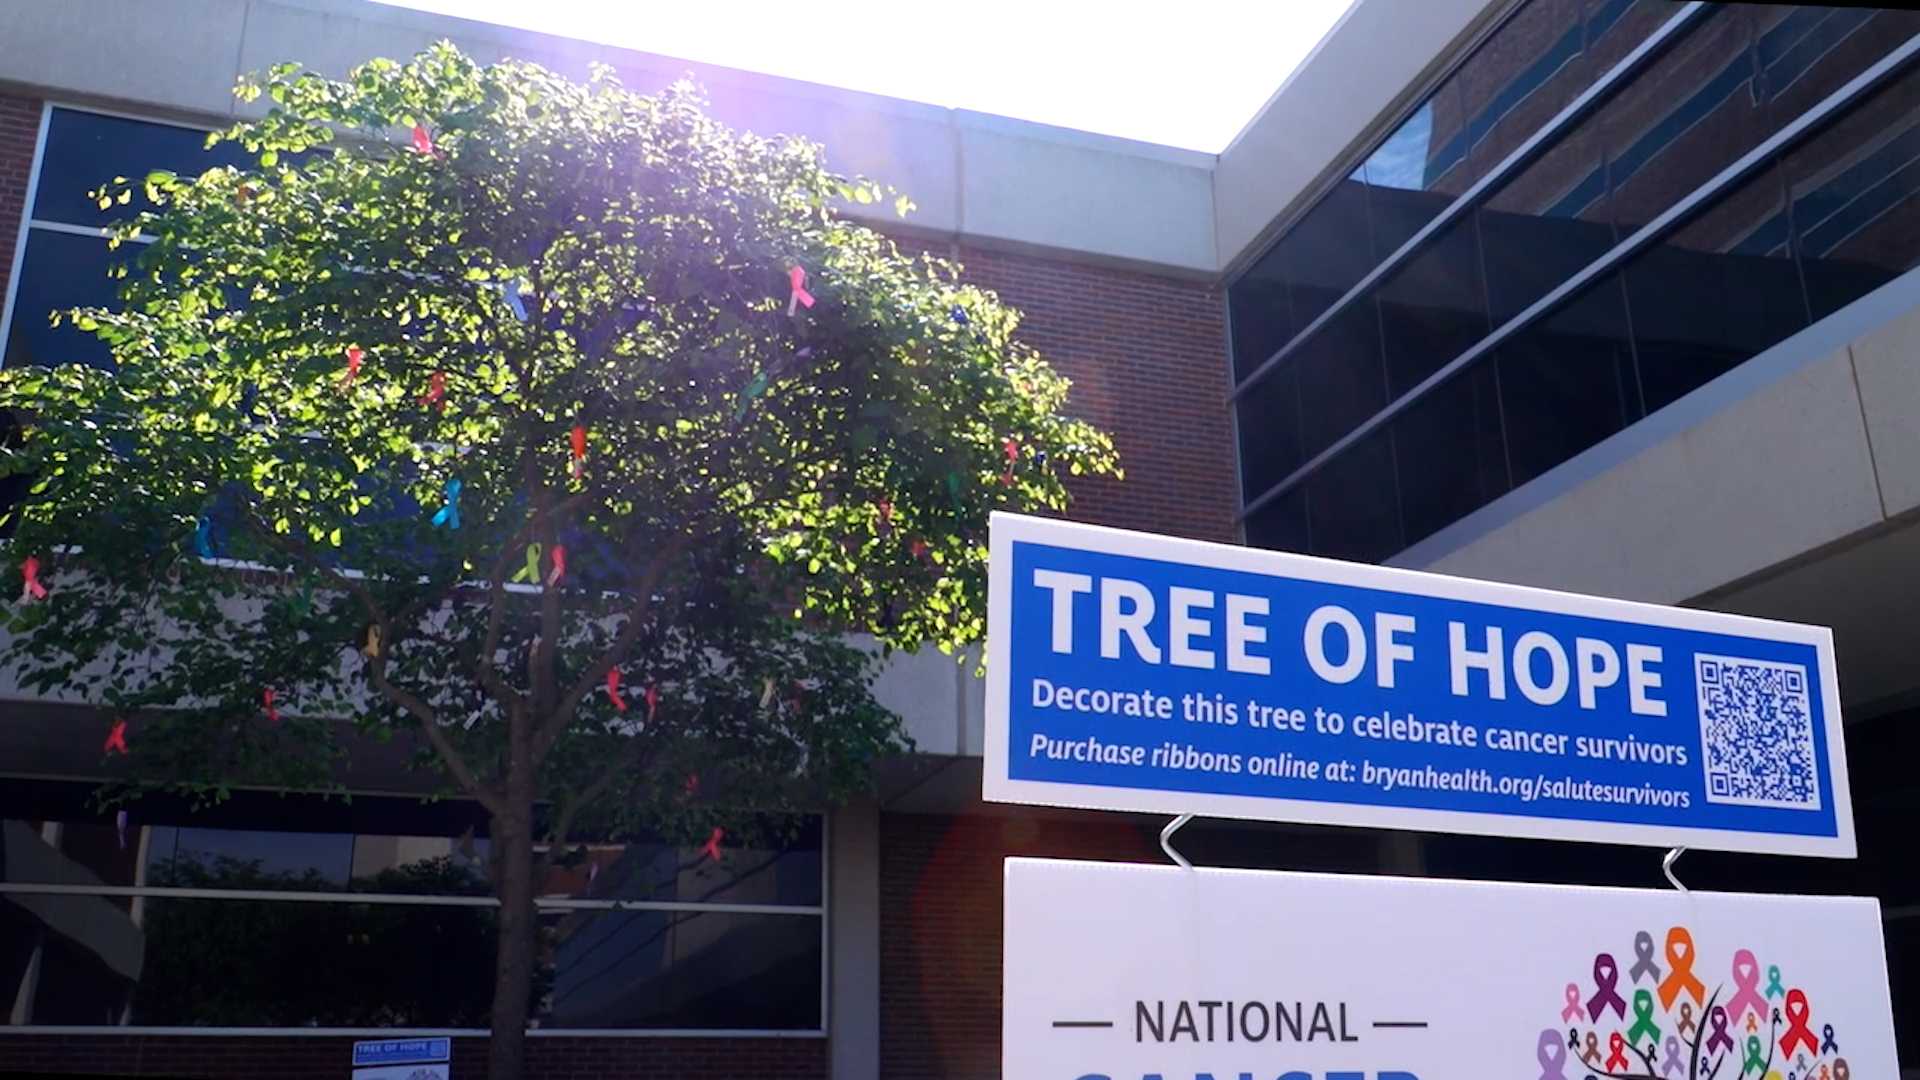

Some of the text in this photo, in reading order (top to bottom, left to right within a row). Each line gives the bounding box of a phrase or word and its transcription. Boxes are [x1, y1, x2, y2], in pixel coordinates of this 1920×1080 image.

[1033, 568, 1667, 717] TREE OF HOPE
[1032, 679, 1687, 766] Decorate this tree to celebrate cancer survivors
[1030, 733, 1691, 808] Purchase ribbons online at: bryanhealth.org/salutesurvivors
[1134, 1000, 1359, 1043] NATIONAL
